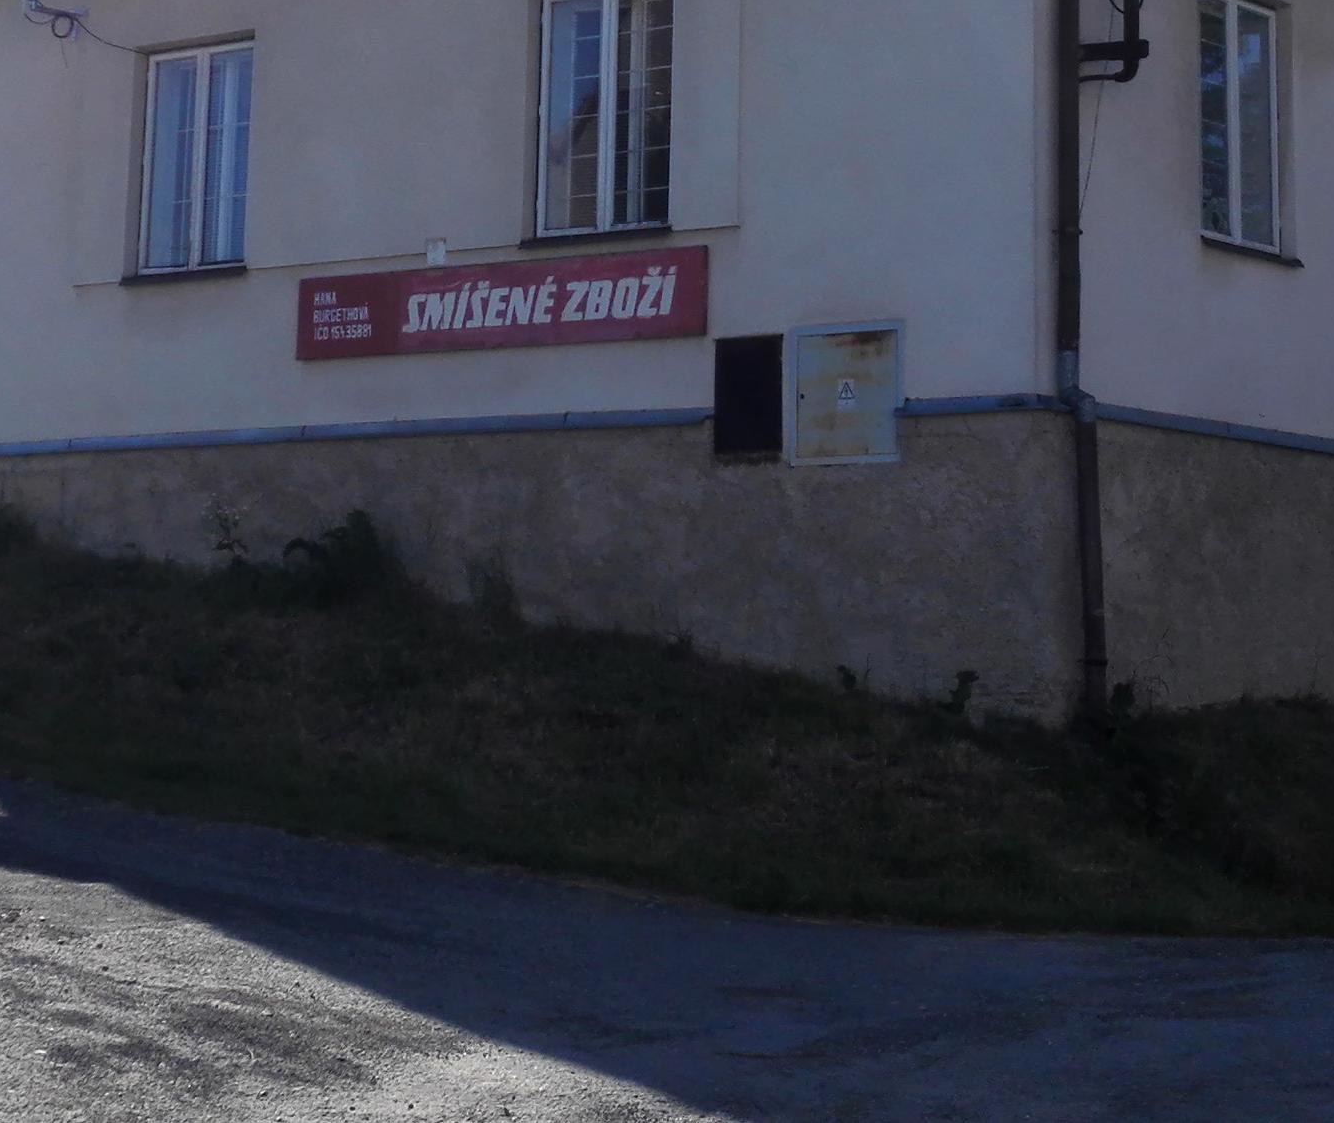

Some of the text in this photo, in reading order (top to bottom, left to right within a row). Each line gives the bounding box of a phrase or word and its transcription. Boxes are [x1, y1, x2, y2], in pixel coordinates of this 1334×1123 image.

[314, 291, 337, 305] HANA
[403, 266, 677, 333] SMÍŠENÉ ZBOŽÍ
